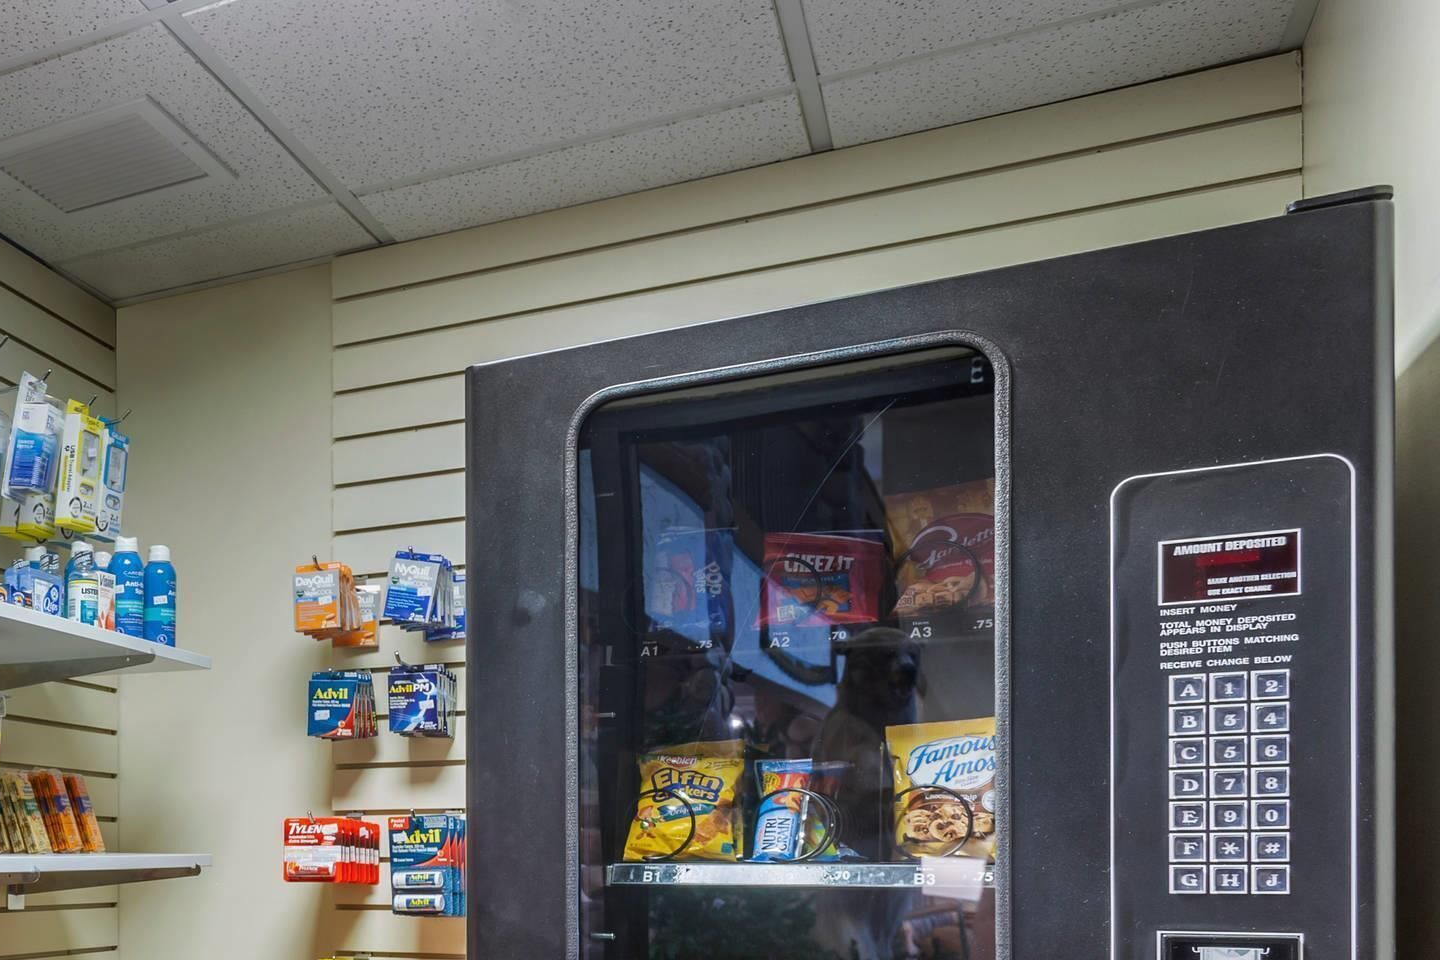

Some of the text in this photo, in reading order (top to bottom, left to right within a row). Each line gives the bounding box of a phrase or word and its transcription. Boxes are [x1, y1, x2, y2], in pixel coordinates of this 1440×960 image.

[1173, 535, 1288, 556] AMOUNT DEPOSITED
[394, 562, 432, 576] NyQuil
[295, 573, 334, 588] DayQuil
[1229, 574, 1260, 584] ANOTHER
[1260, 570, 1297, 581] SELECTION
[1222, 586, 1244, 595] EXACT
[1244, 584, 1273, 594] CHANGE
[1160, 603, 1238, 616] INSERT MONEY
[1160, 613, 1296, 630] TOTAL MONEY DEPOSITED
[910, 627, 933, 639] A3
[1160, 622, 1269, 637] APPEARS IN DISPLAY
[769, 637, 791, 649] A2
[1160, 633, 1299, 650] PUSH BUTTONS MATCHING
[1160, 645, 1233, 657] DESIRED ITEM
[1160, 654, 1292, 670] RECEIVE CHANGE BELOW
[389, 682, 430, 694] Advil PM
[1180, 684, 1197, 697] A
[1224, 682, 1234, 695] 1
[1265, 680, 1278, 693] 2
[313, 687, 349, 700] Advil
[1182, 715, 1197, 728] B
[1223, 714, 1236, 727] 3
[1264, 712, 1277, 725] 4
[906, 735, 996, 776] Famous
[1181, 747, 1197, 760] C
[1223, 747, 1236, 759] 5
[1264, 745, 1278, 757] 6
[931, 754, 996, 785] Amos
[652, 768, 721, 790] Elfin
[1182, 779, 1199, 792] D
[1223, 778, 1235, 791] 7
[1265, 777, 1278, 789] 8
[1182, 811, 1197, 824] E
[1223, 811, 1236, 823] 9
[1265, 809, 1278, 822] 0
[288, 822, 323, 835] TYLEN
[761, 817, 778, 851] NUTRI
[775, 816, 791, 851] GRAIN
[1183, 842, 1198, 855] F
[642, 870, 660, 883] B1
[913, 873, 936, 886] B3
[1181, 874, 1198, 886] G
[1222, 874, 1240, 887] H
[1265, 874, 1279, 887] J
